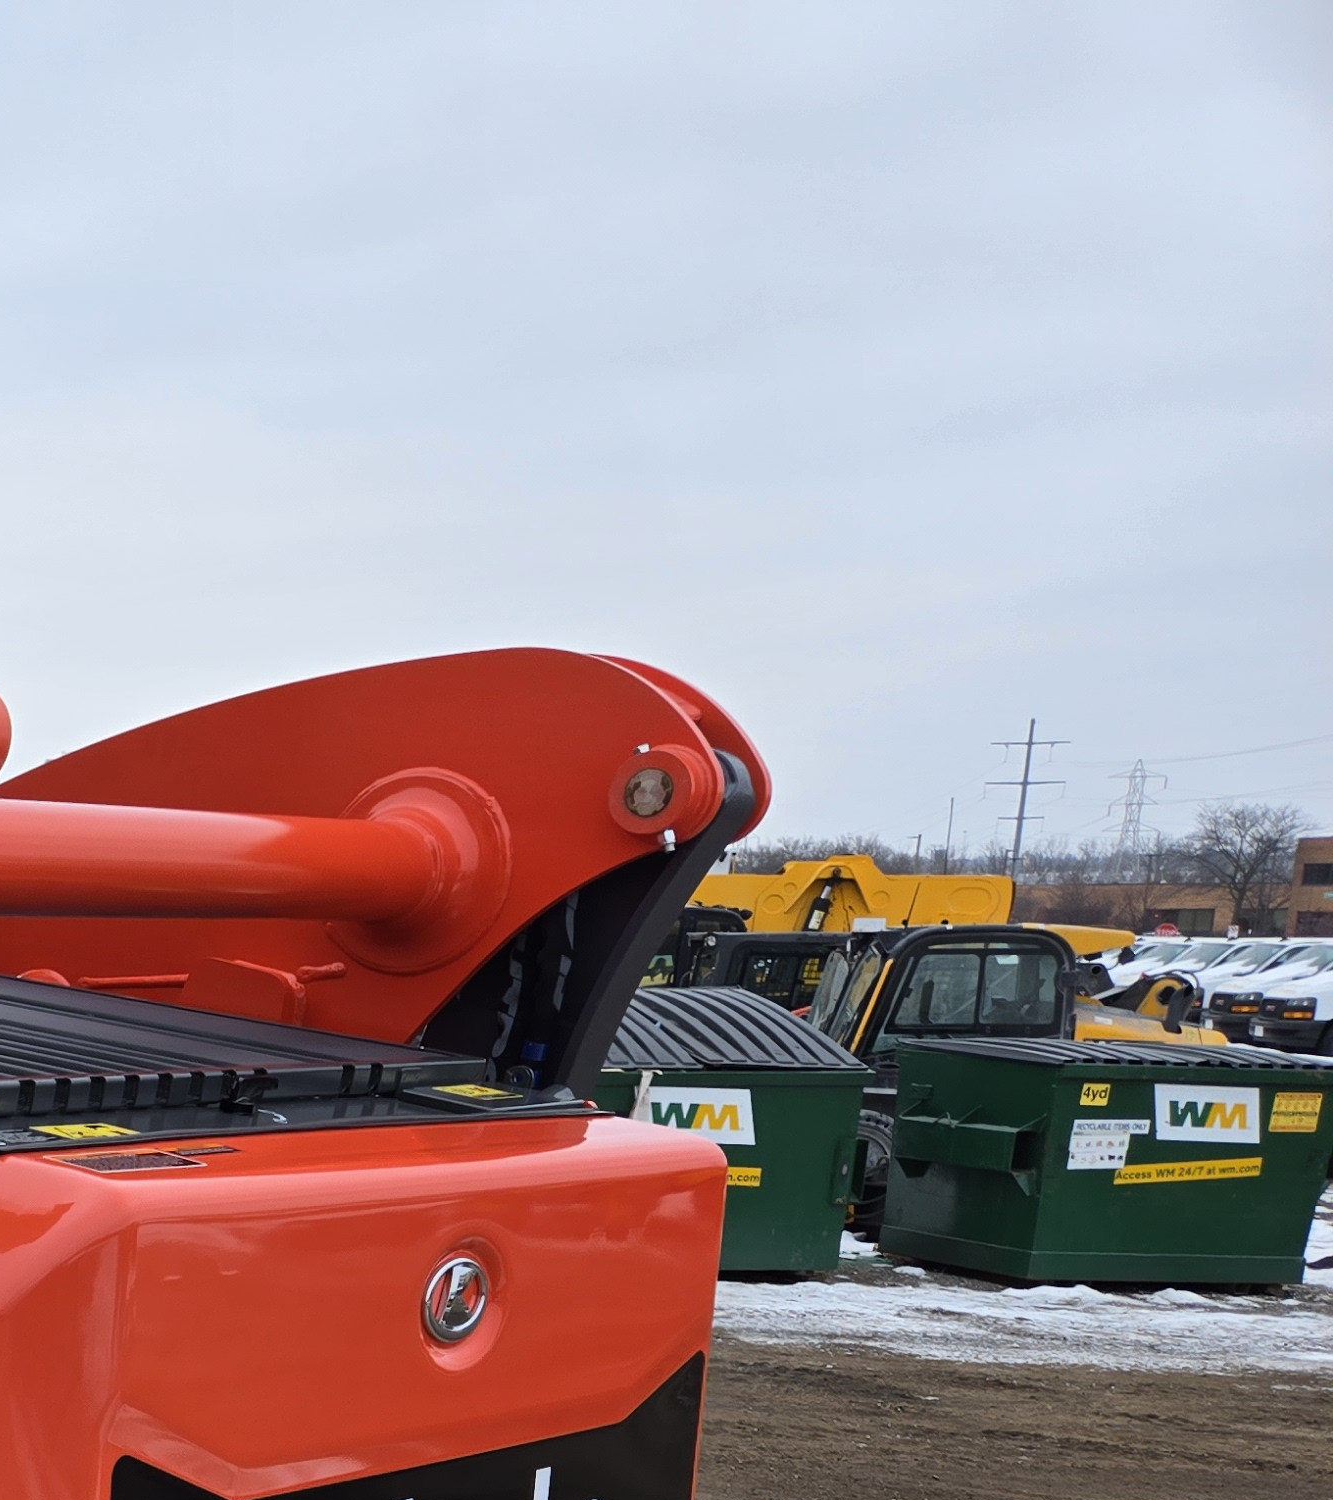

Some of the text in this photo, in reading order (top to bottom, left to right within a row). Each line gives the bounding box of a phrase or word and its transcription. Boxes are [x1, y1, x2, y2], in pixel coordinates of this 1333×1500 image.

[1083, 1086, 1109, 1102] 4yd
[651, 1102, 740, 1131] WM
[1169, 1100, 1248, 1130] WM
[1076, 1123, 1111, 1131] RECYCLABLE
[1132, 1123, 1148, 1131] ONLY
[1115, 1164, 1260, 1180] Access WM 24/7 at wm.com
